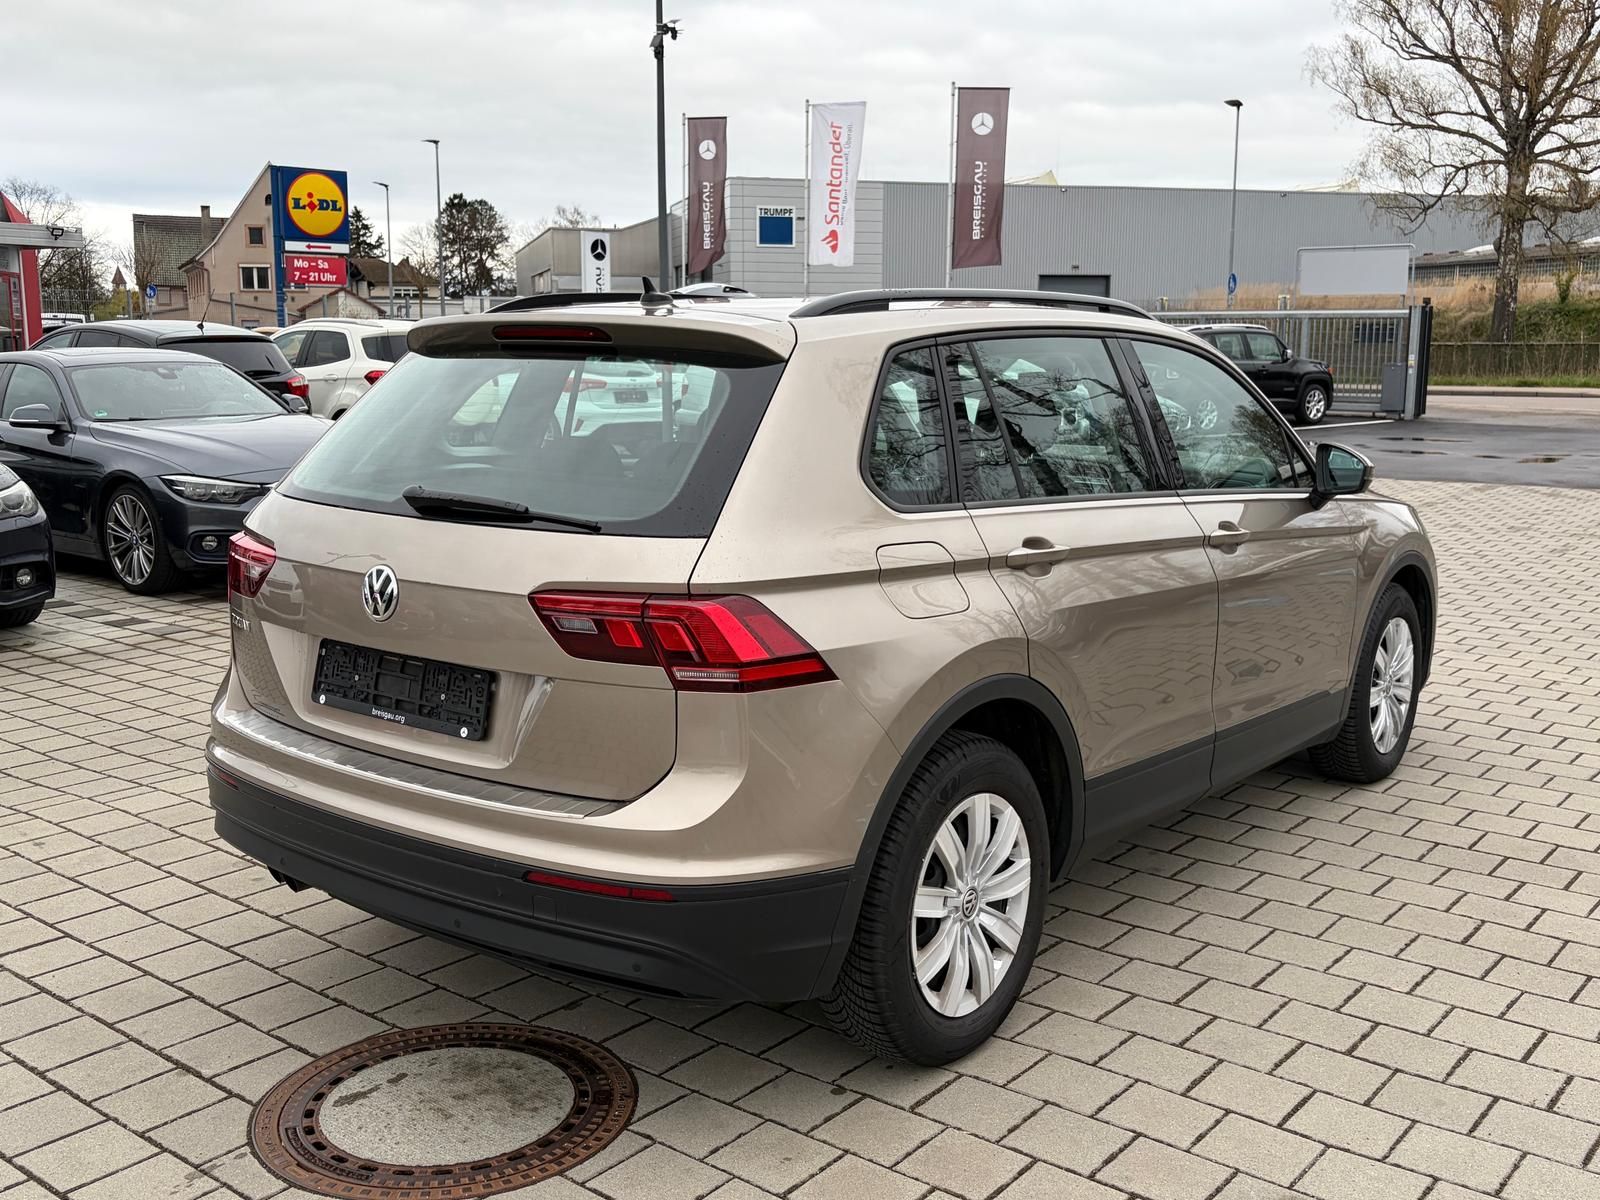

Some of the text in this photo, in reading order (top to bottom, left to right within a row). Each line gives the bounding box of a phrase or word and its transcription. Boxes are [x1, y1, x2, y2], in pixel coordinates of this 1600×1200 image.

[824, 121, 844, 226] Santander
[972, 161, 983, 240] BREISGAU
[702, 182, 711, 249] BREISGAU
[758, 207, 794, 217] TRUMPF
[294, 259, 309, 268] Mo
[317, 259, 329, 269] Sa
[294, 271, 300, 281] 7
[308, 272, 319, 281] 21
[320, 272, 337, 282] Uhr
[372, 707, 405, 723] breisgau.org
